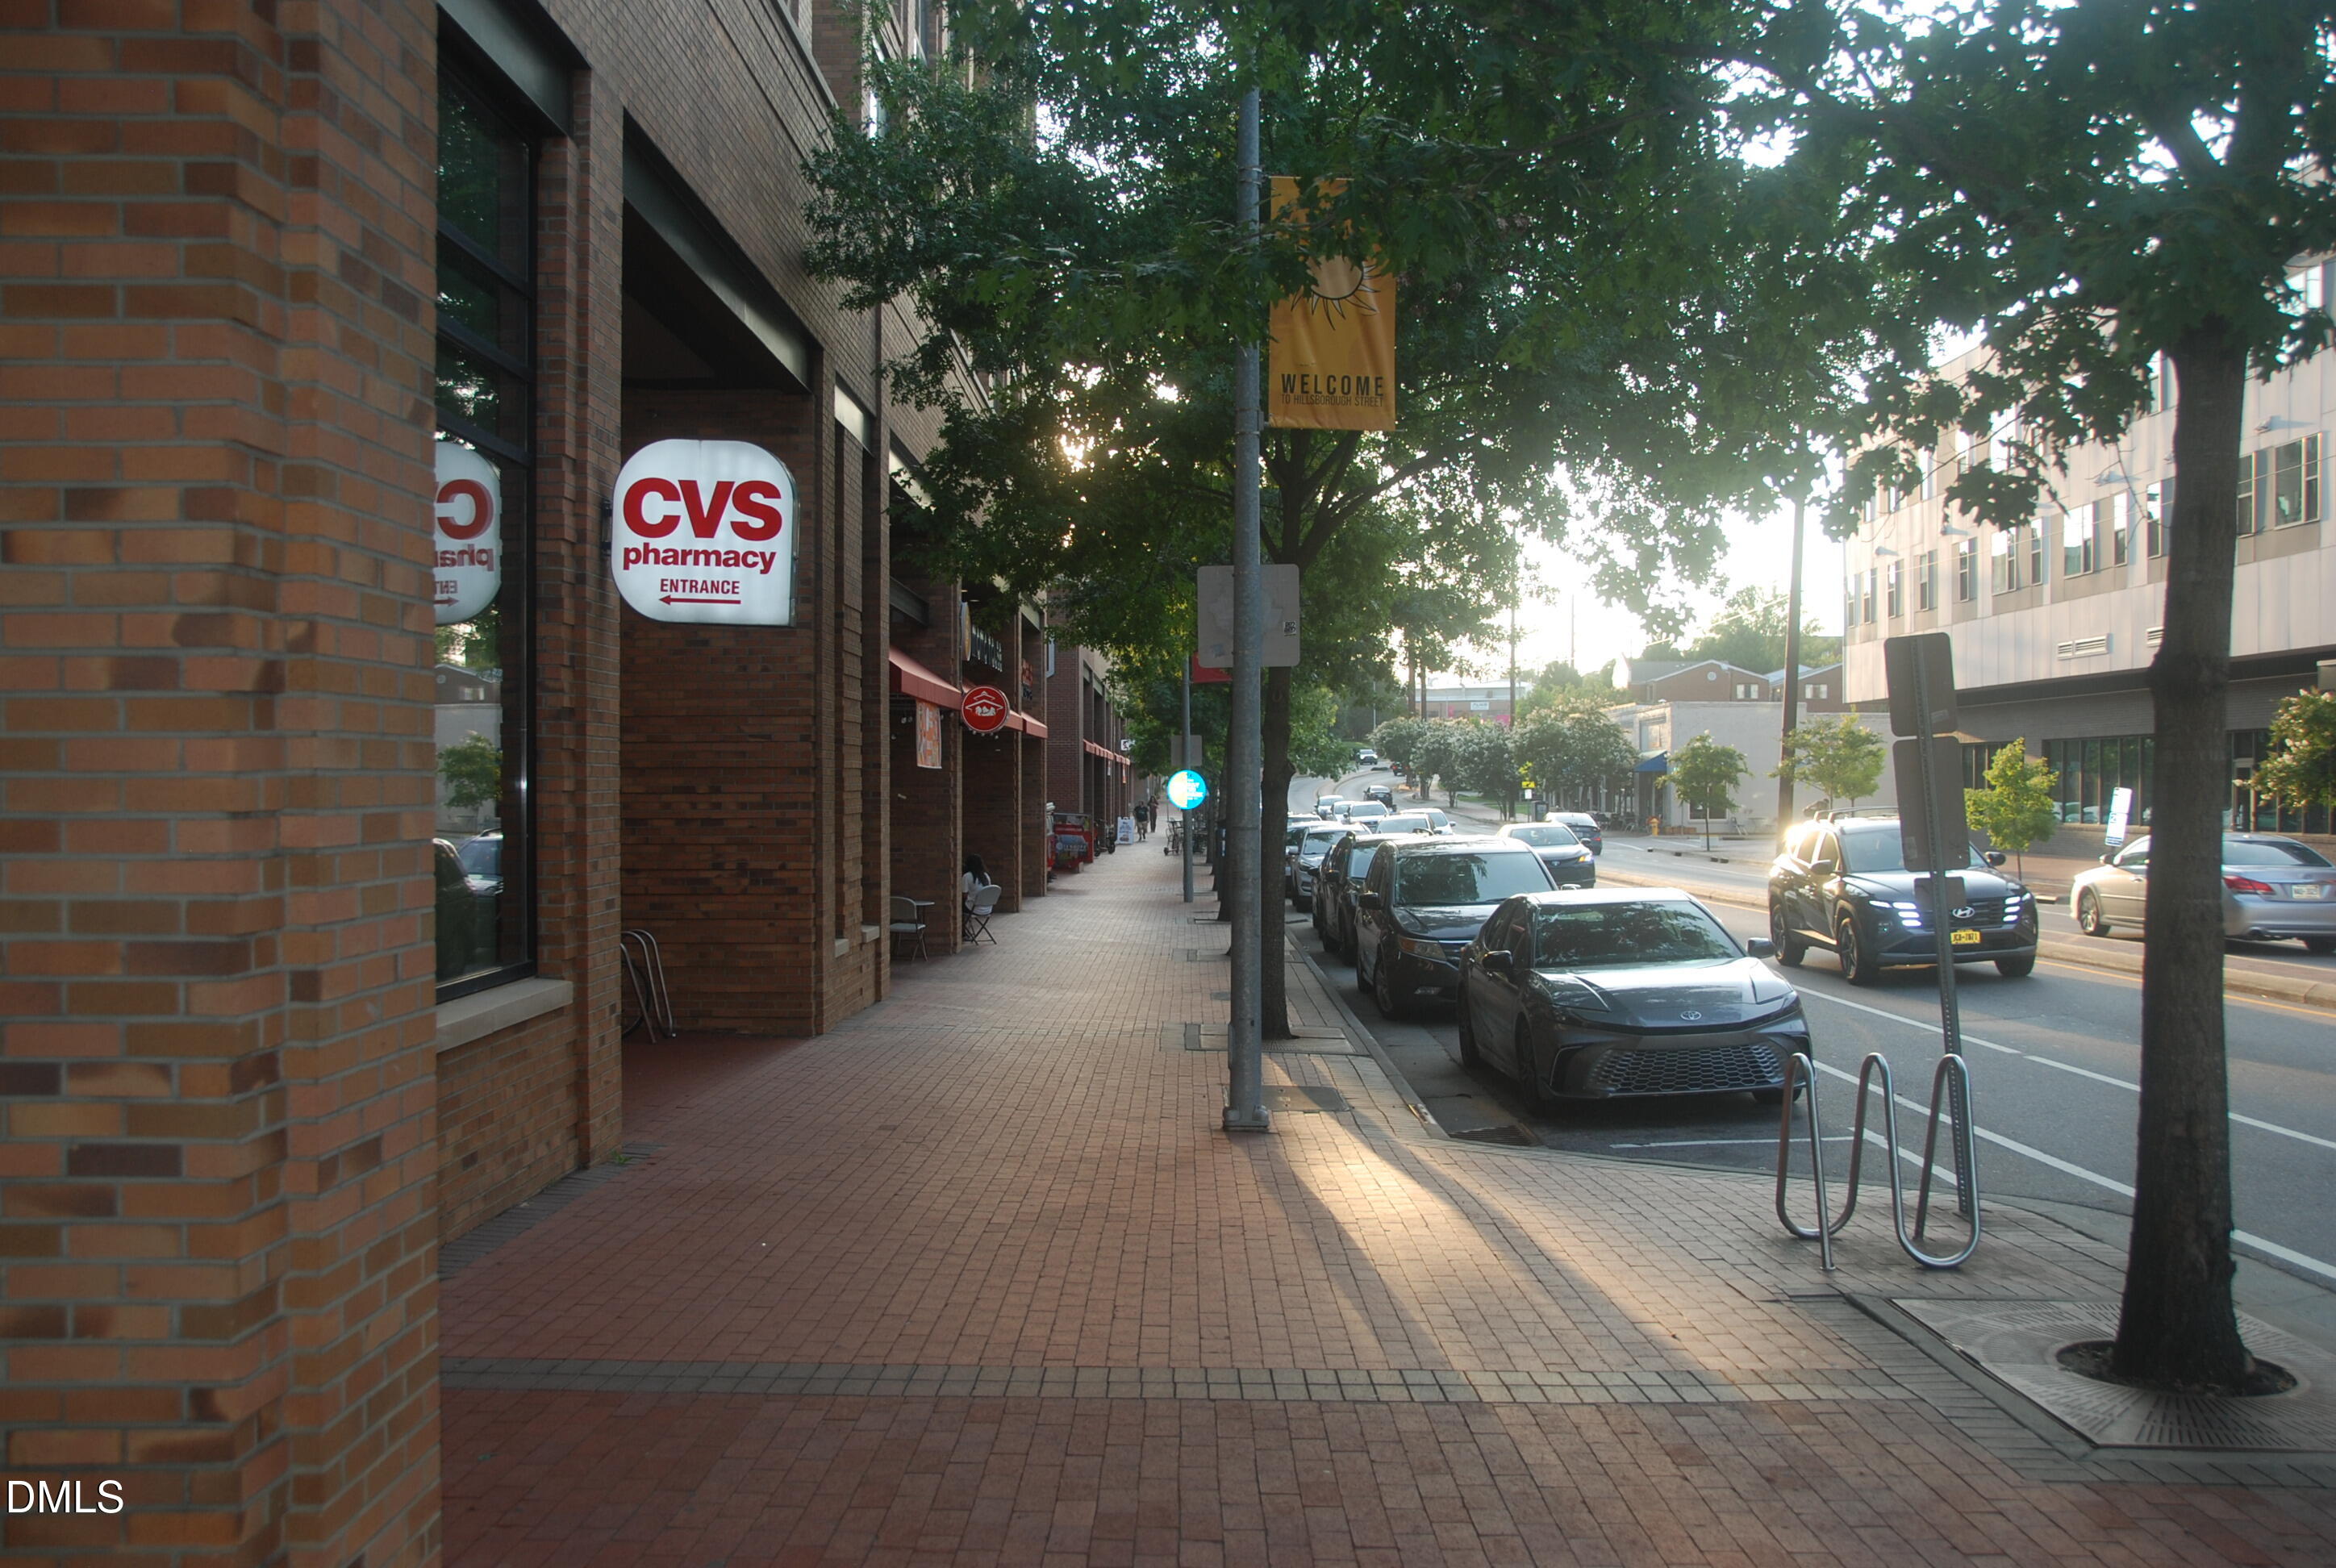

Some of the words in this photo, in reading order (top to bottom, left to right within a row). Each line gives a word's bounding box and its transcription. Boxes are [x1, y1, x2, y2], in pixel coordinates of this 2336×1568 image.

[1281, 373, 1384, 397] WELCOME
[1281, 393, 1291, 404] TO
[1294, 393, 1352, 407] HILLSBOROUGH
[1354, 395, 1384, 407] STREET
[623, 477, 782, 541] CVS
[623, 542, 776, 575] pharmacy
[660, 578, 740, 595] ENTRANCE
